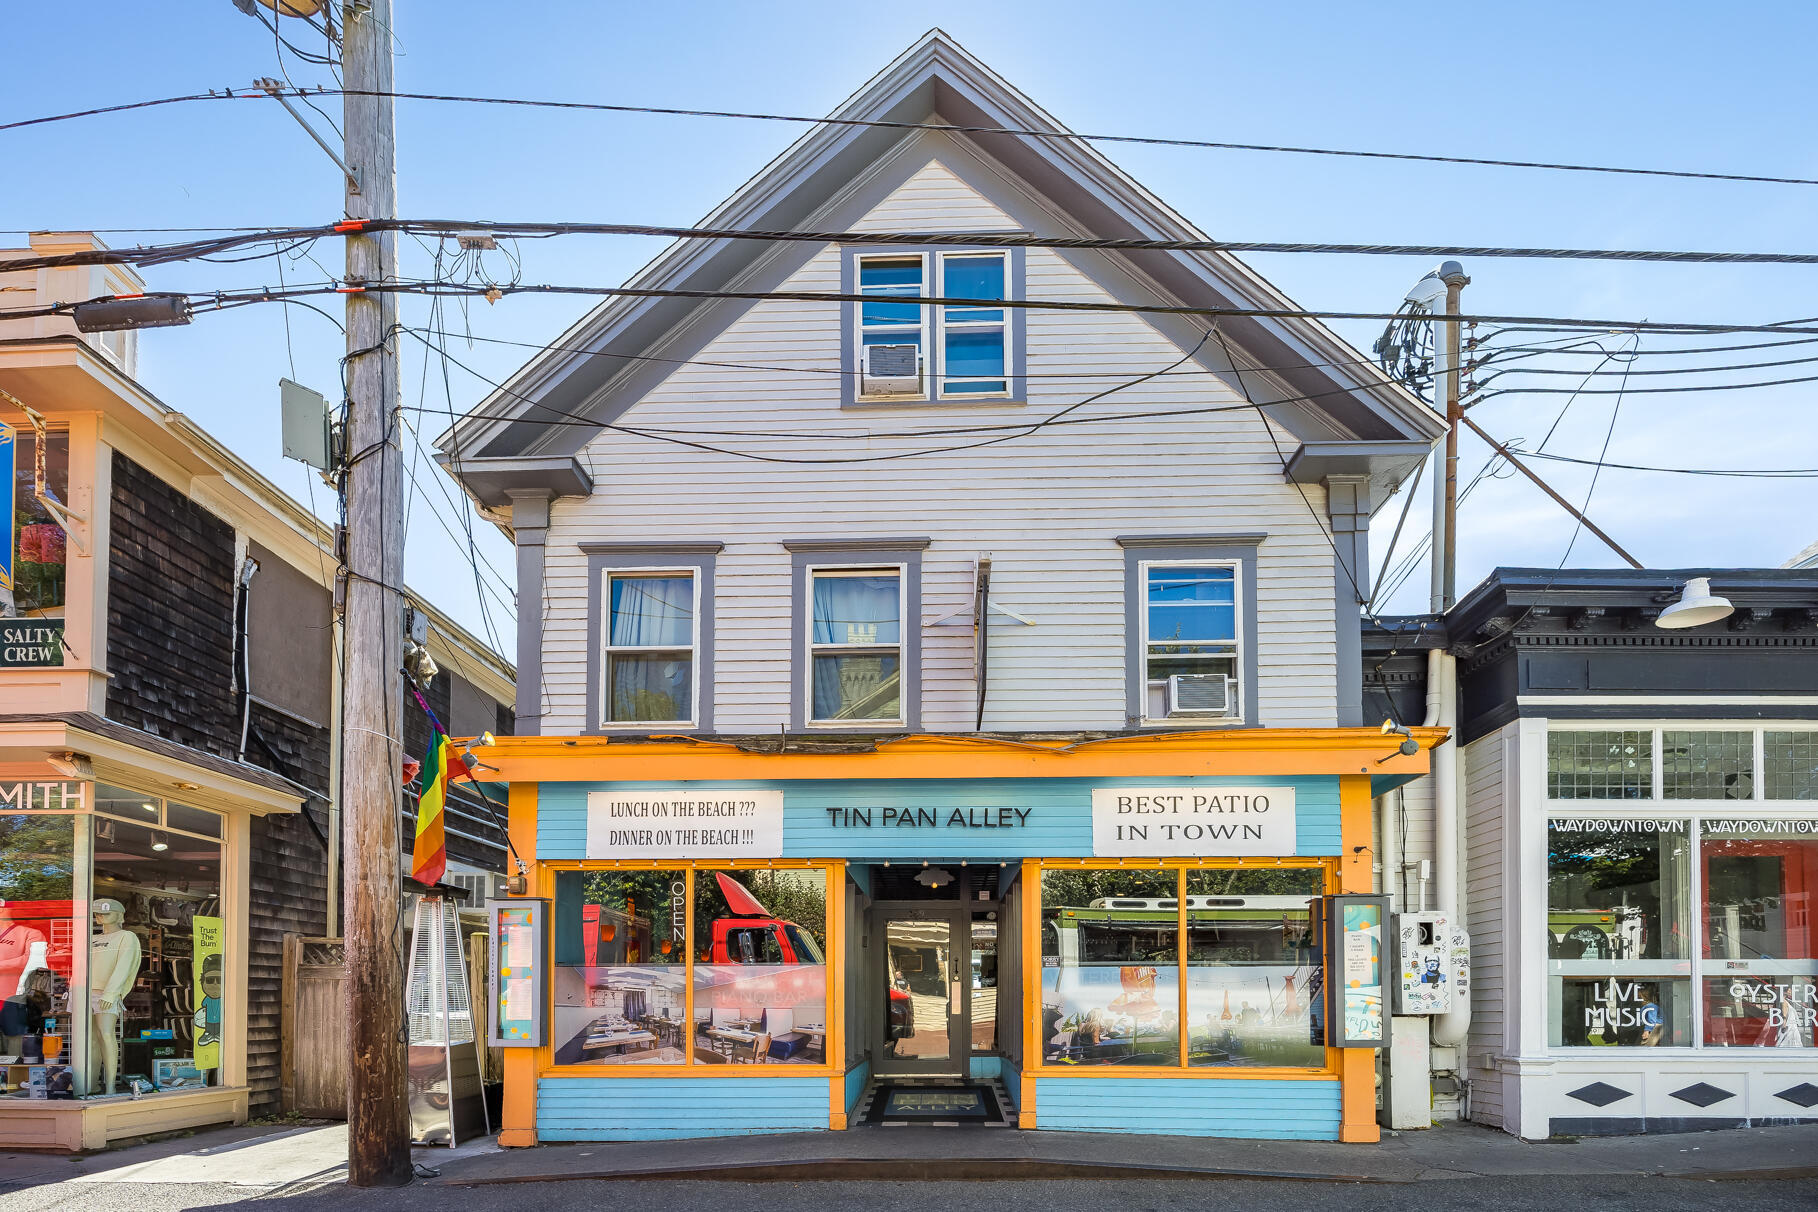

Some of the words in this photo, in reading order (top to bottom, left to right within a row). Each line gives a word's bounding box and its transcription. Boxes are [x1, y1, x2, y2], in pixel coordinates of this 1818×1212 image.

[4, 628, 55, 643] SALTY
[4, 646, 54, 662] CREW
[610, 802, 648, 818] LUNCH
[652, 802, 669, 817] ON
[672, 802, 695, 817] THE
[697, 801, 736, 817] BEACH
[739, 801, 756, 816] ???
[1117, 796, 1183, 814] BEST
[1193, 795, 1270, 813] PATIO
[826, 807, 872, 827] TIN
[882, 807, 937, 827] PAN
[946, 807, 1033, 828] ALLEY
[1552, 819, 1684, 833] WAYDOWNTOWN
[609, 830, 653, 846] DINNER
[656, 830, 673, 845] ON
[675, 830, 698, 845] THE
[701, 829, 739, 845] BEACH
[742, 829, 754, 845] !!!
[1116, 825, 1149, 841] IN
[1160, 824, 1264, 840] TOWN
[671, 881, 686, 942] OPEN
[199, 926, 218, 935] Trust
[200, 933, 214, 941] The
[711, 991, 768, 1003] PIANO
[774, 991, 807, 1003] BAR
[1594, 982, 1646, 1002] LIVE
[1729, 984, 1818, 1004] OYSTER
